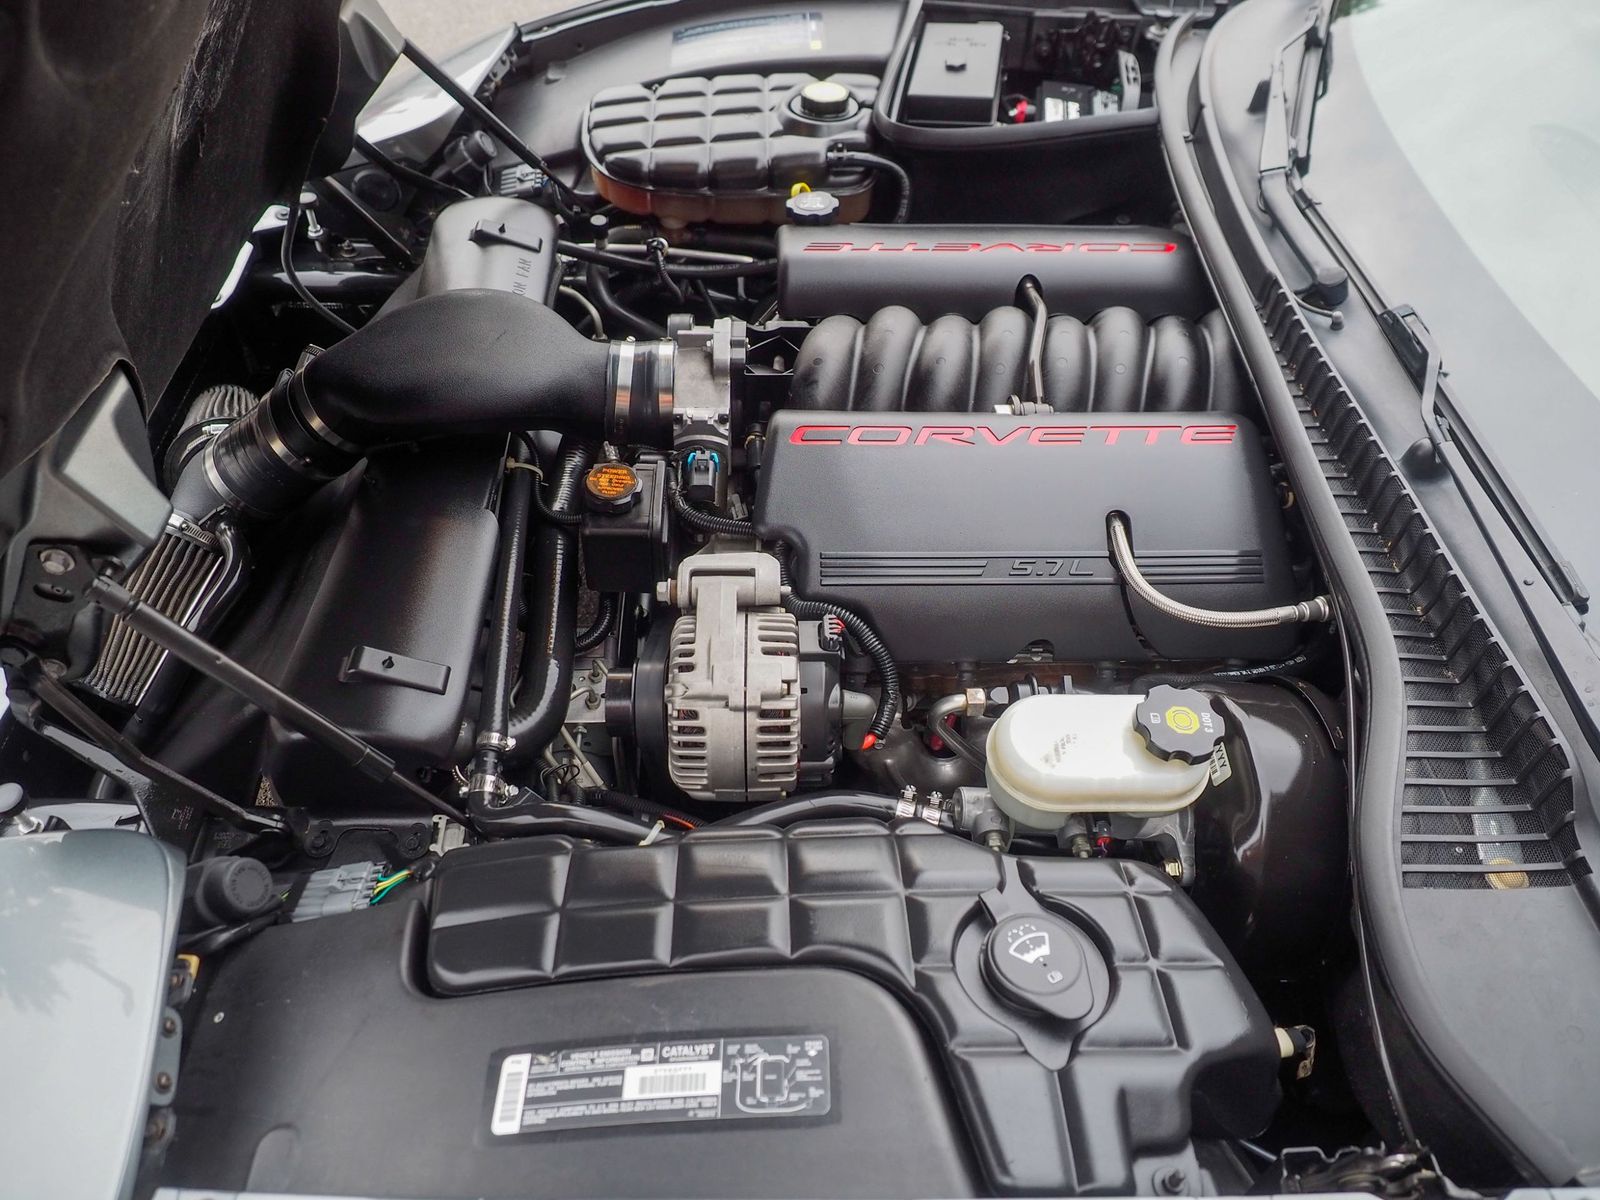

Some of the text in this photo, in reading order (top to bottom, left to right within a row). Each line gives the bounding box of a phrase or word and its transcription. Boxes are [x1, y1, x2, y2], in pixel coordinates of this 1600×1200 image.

[803, 242, 1177, 254] CORVETTE
[789, 424, 1238, 446] CORVETTE
[1008, 559, 1094, 576] 5.7L
[1200, 712, 1211, 728] DOT
[1215, 745, 1228, 769] YYY
[661, 1043, 714, 1059] CATALYST
